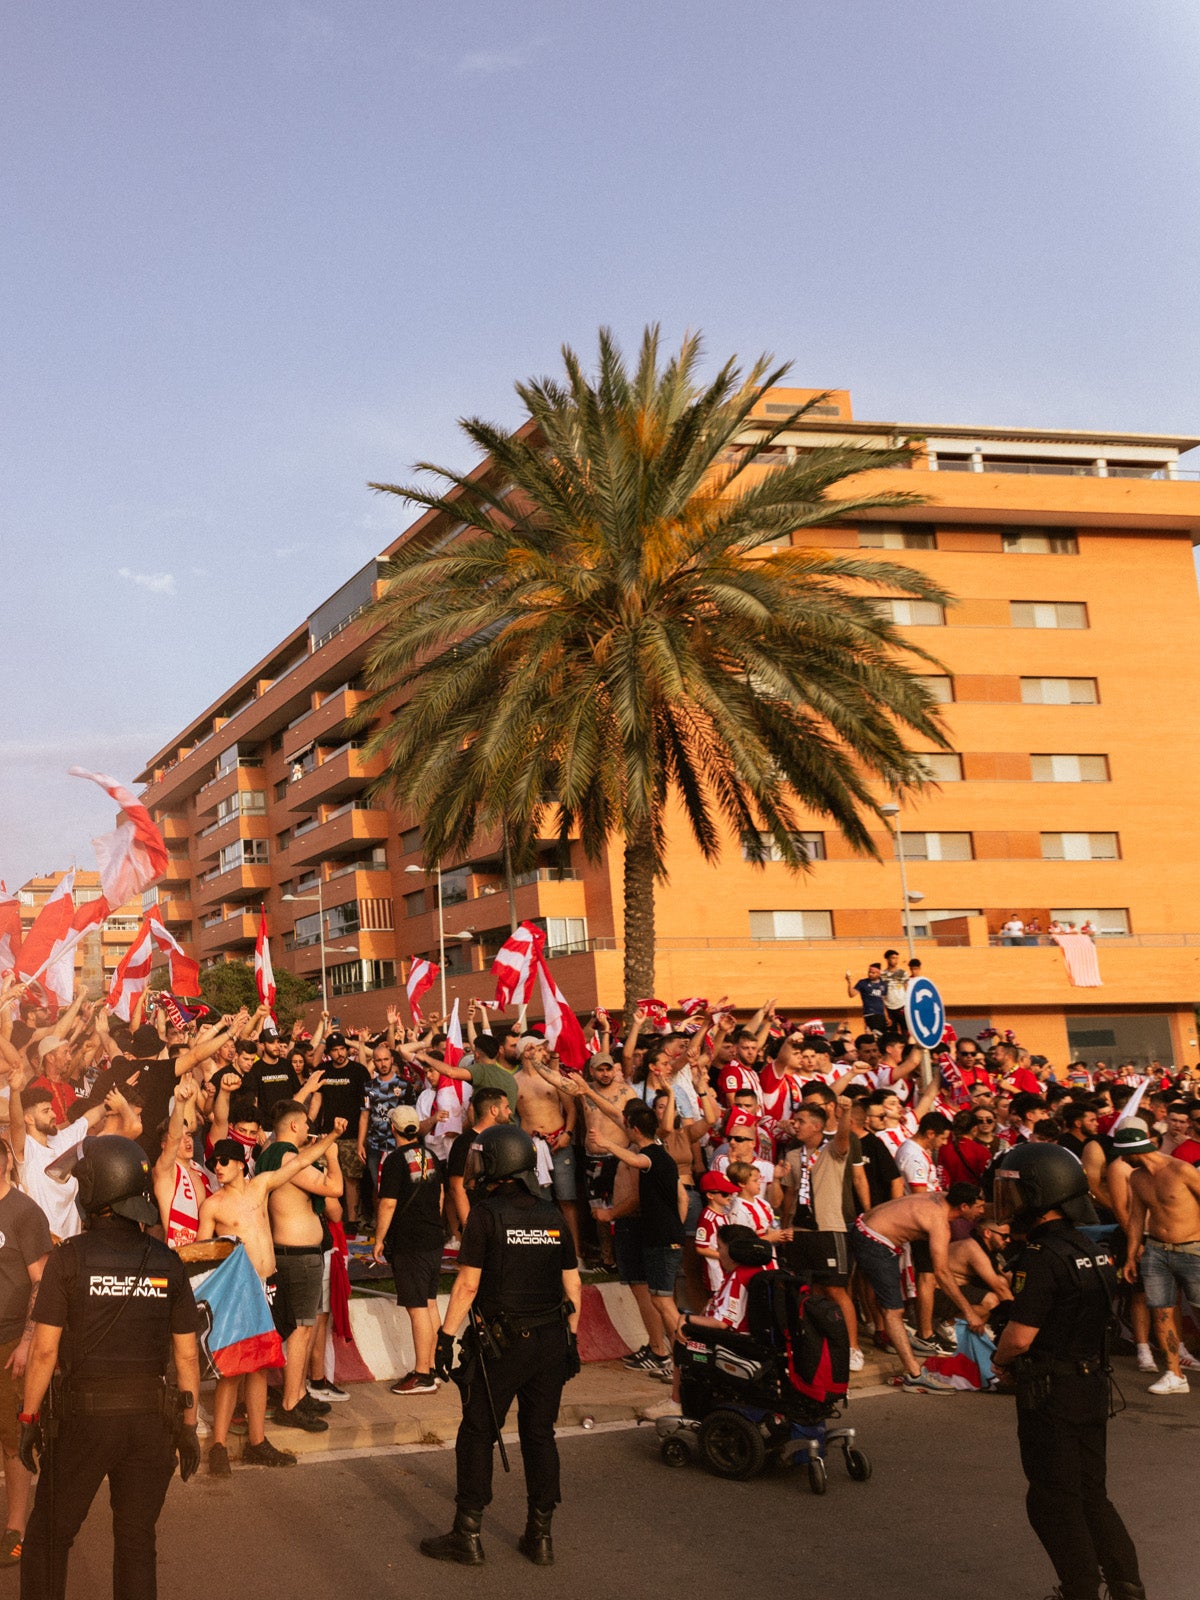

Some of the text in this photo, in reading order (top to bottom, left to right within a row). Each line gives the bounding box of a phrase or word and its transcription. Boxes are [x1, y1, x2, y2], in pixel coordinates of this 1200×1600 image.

[506, 1229, 550, 1237] POLICIA
[506, 1236, 561, 1245] NACIONAL
[89, 1276, 153, 1287] POLICIA
[89, 1285, 168, 1298] NACIONAL
